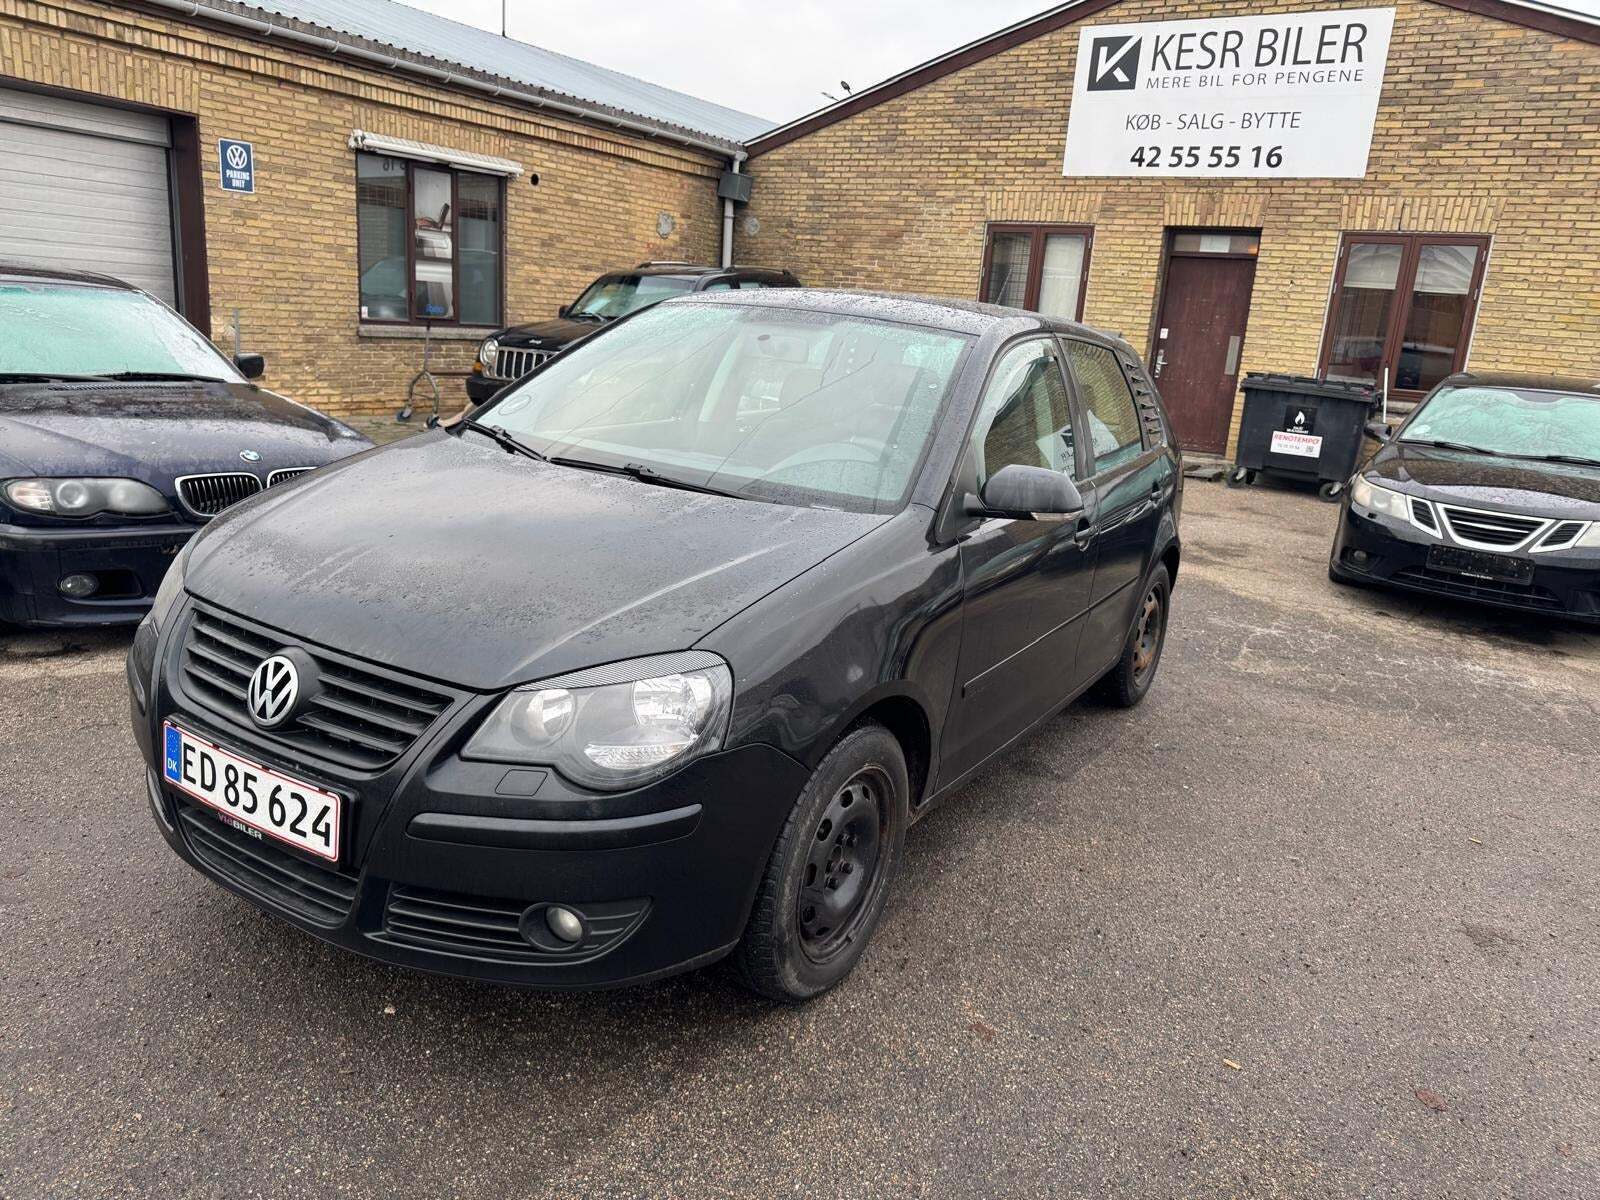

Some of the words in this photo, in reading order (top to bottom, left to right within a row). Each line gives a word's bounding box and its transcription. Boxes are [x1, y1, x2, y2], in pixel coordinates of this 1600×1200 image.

[1151, 30, 1244, 72] KESR
[1254, 22, 1368, 68] BILER
[1146, 75, 1191, 90] MERE
[1199, 74, 1225, 88] BIL
[1232, 73, 1267, 86] FOR
[1275, 69, 1364, 85] PENGENE
[1125, 113, 1162, 131] KØB
[1176, 112, 1225, 131] SALG
[1240, 111, 1302, 130] BYTTE
[1129, 145, 1162, 168] 42
[1168, 145, 1201, 168] 55
[1207, 145, 1241, 168] 55
[1251, 145, 1283, 168] 16
[167, 757, 178, 773] DK
[183, 742, 217, 793] ED
[224, 763, 258, 814] 85
[268, 784, 331, 848] 624
